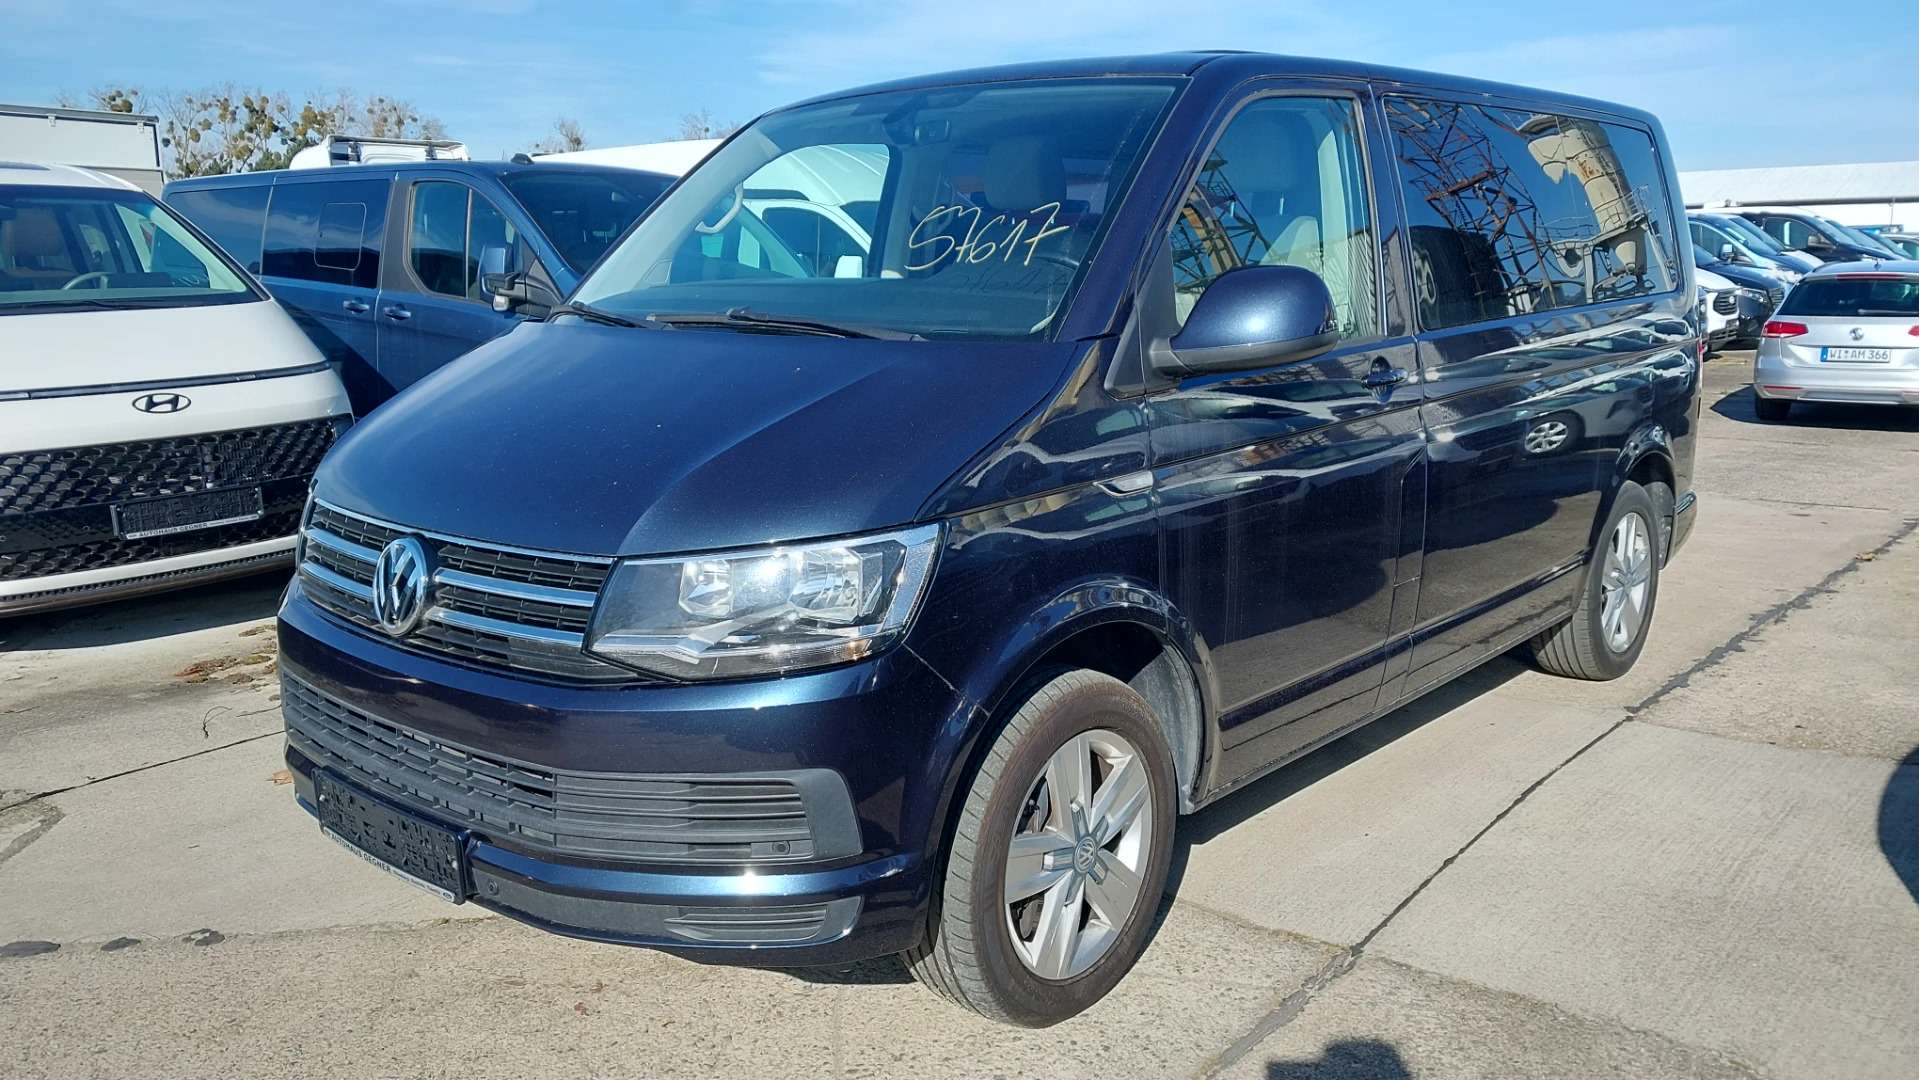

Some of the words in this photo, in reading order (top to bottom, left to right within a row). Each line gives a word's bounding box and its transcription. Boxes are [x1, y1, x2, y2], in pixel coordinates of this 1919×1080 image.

[1867, 350, 1889, 360] 366
[140, 527, 178, 537] AUTOHAUS
[331, 832, 363, 858] AUTOHAUS
